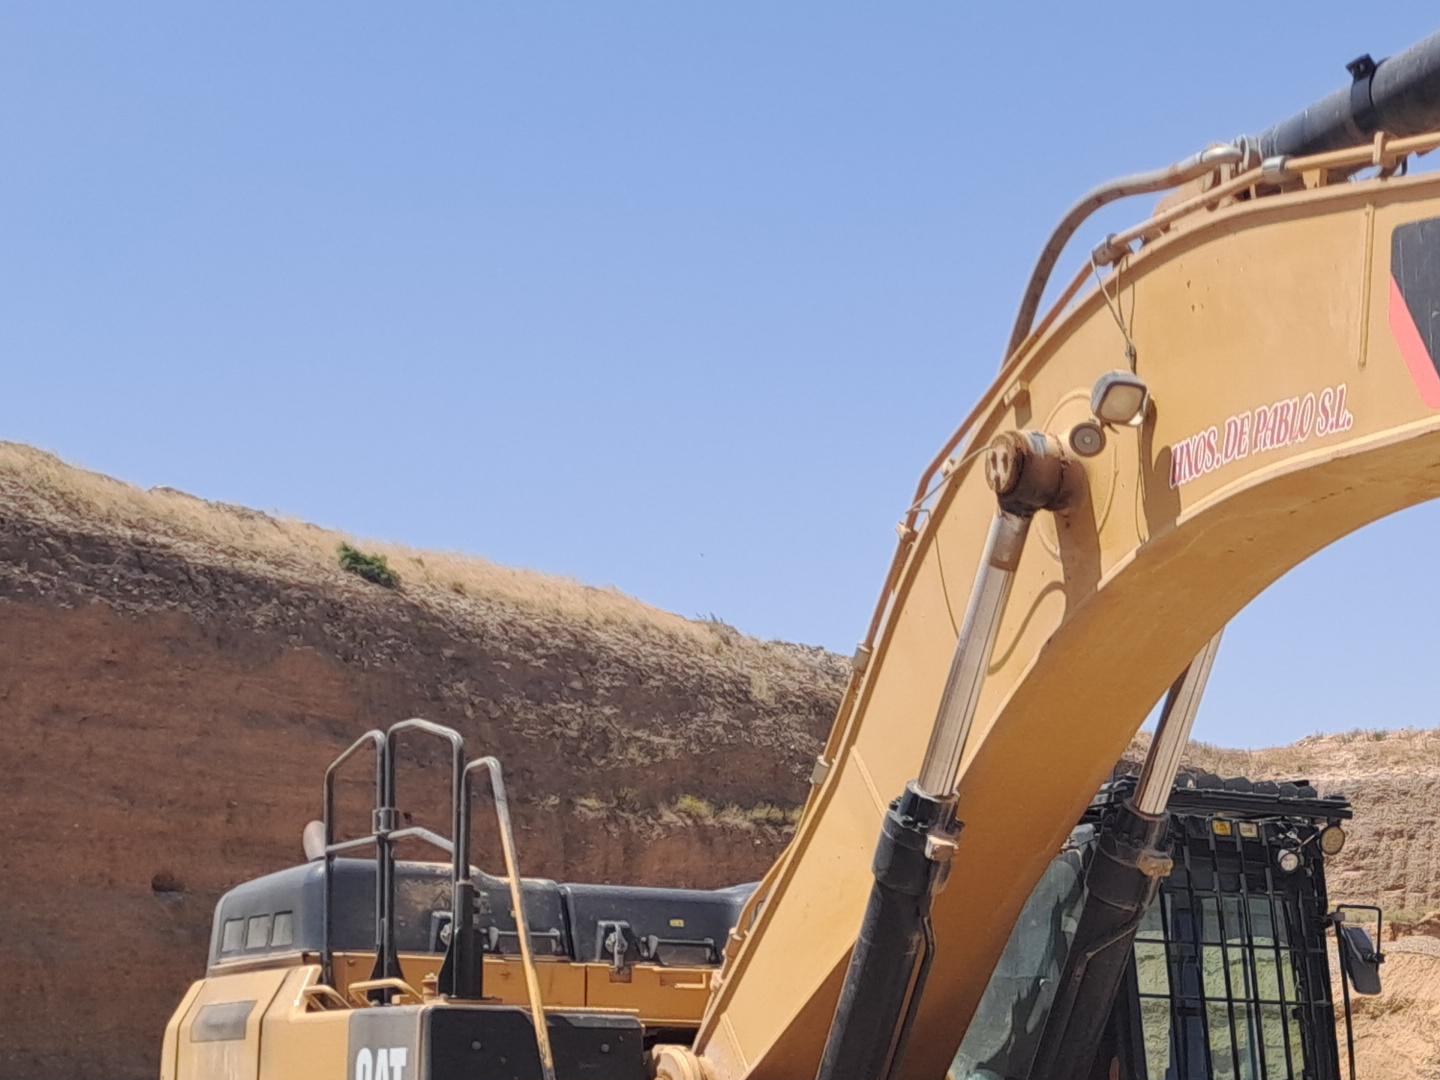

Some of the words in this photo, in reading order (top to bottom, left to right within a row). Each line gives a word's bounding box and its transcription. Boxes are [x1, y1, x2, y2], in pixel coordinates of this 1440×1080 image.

[1223, 411, 1251, 464] DE
[1252, 392, 1316, 455] PABLO
[1316, 383, 1353, 436] S.L.
